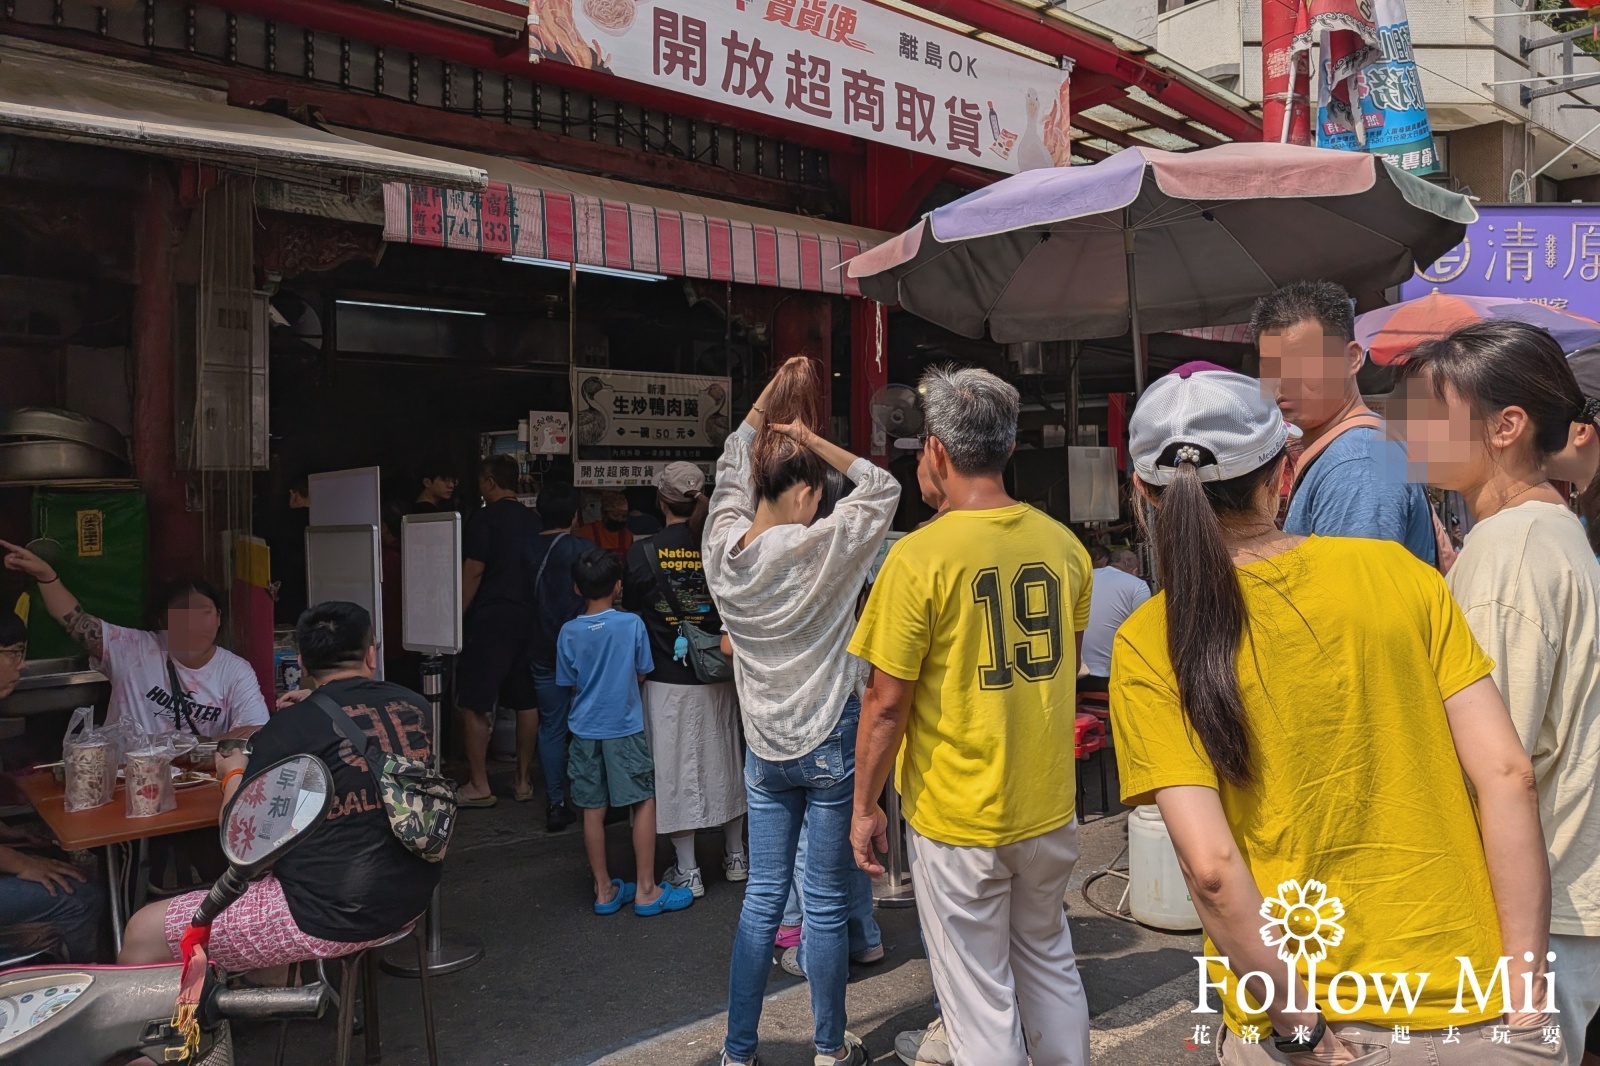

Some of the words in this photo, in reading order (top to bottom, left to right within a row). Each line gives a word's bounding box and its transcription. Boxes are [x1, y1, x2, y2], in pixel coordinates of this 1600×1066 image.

[652, 6, 983, 158] 開放超商取貨
[656, 428, 670, 439] 50
[676, 427, 686, 439] 元
[581, 465, 654, 478] 開放超商取貨
[971, 562, 1063, 690] 19
